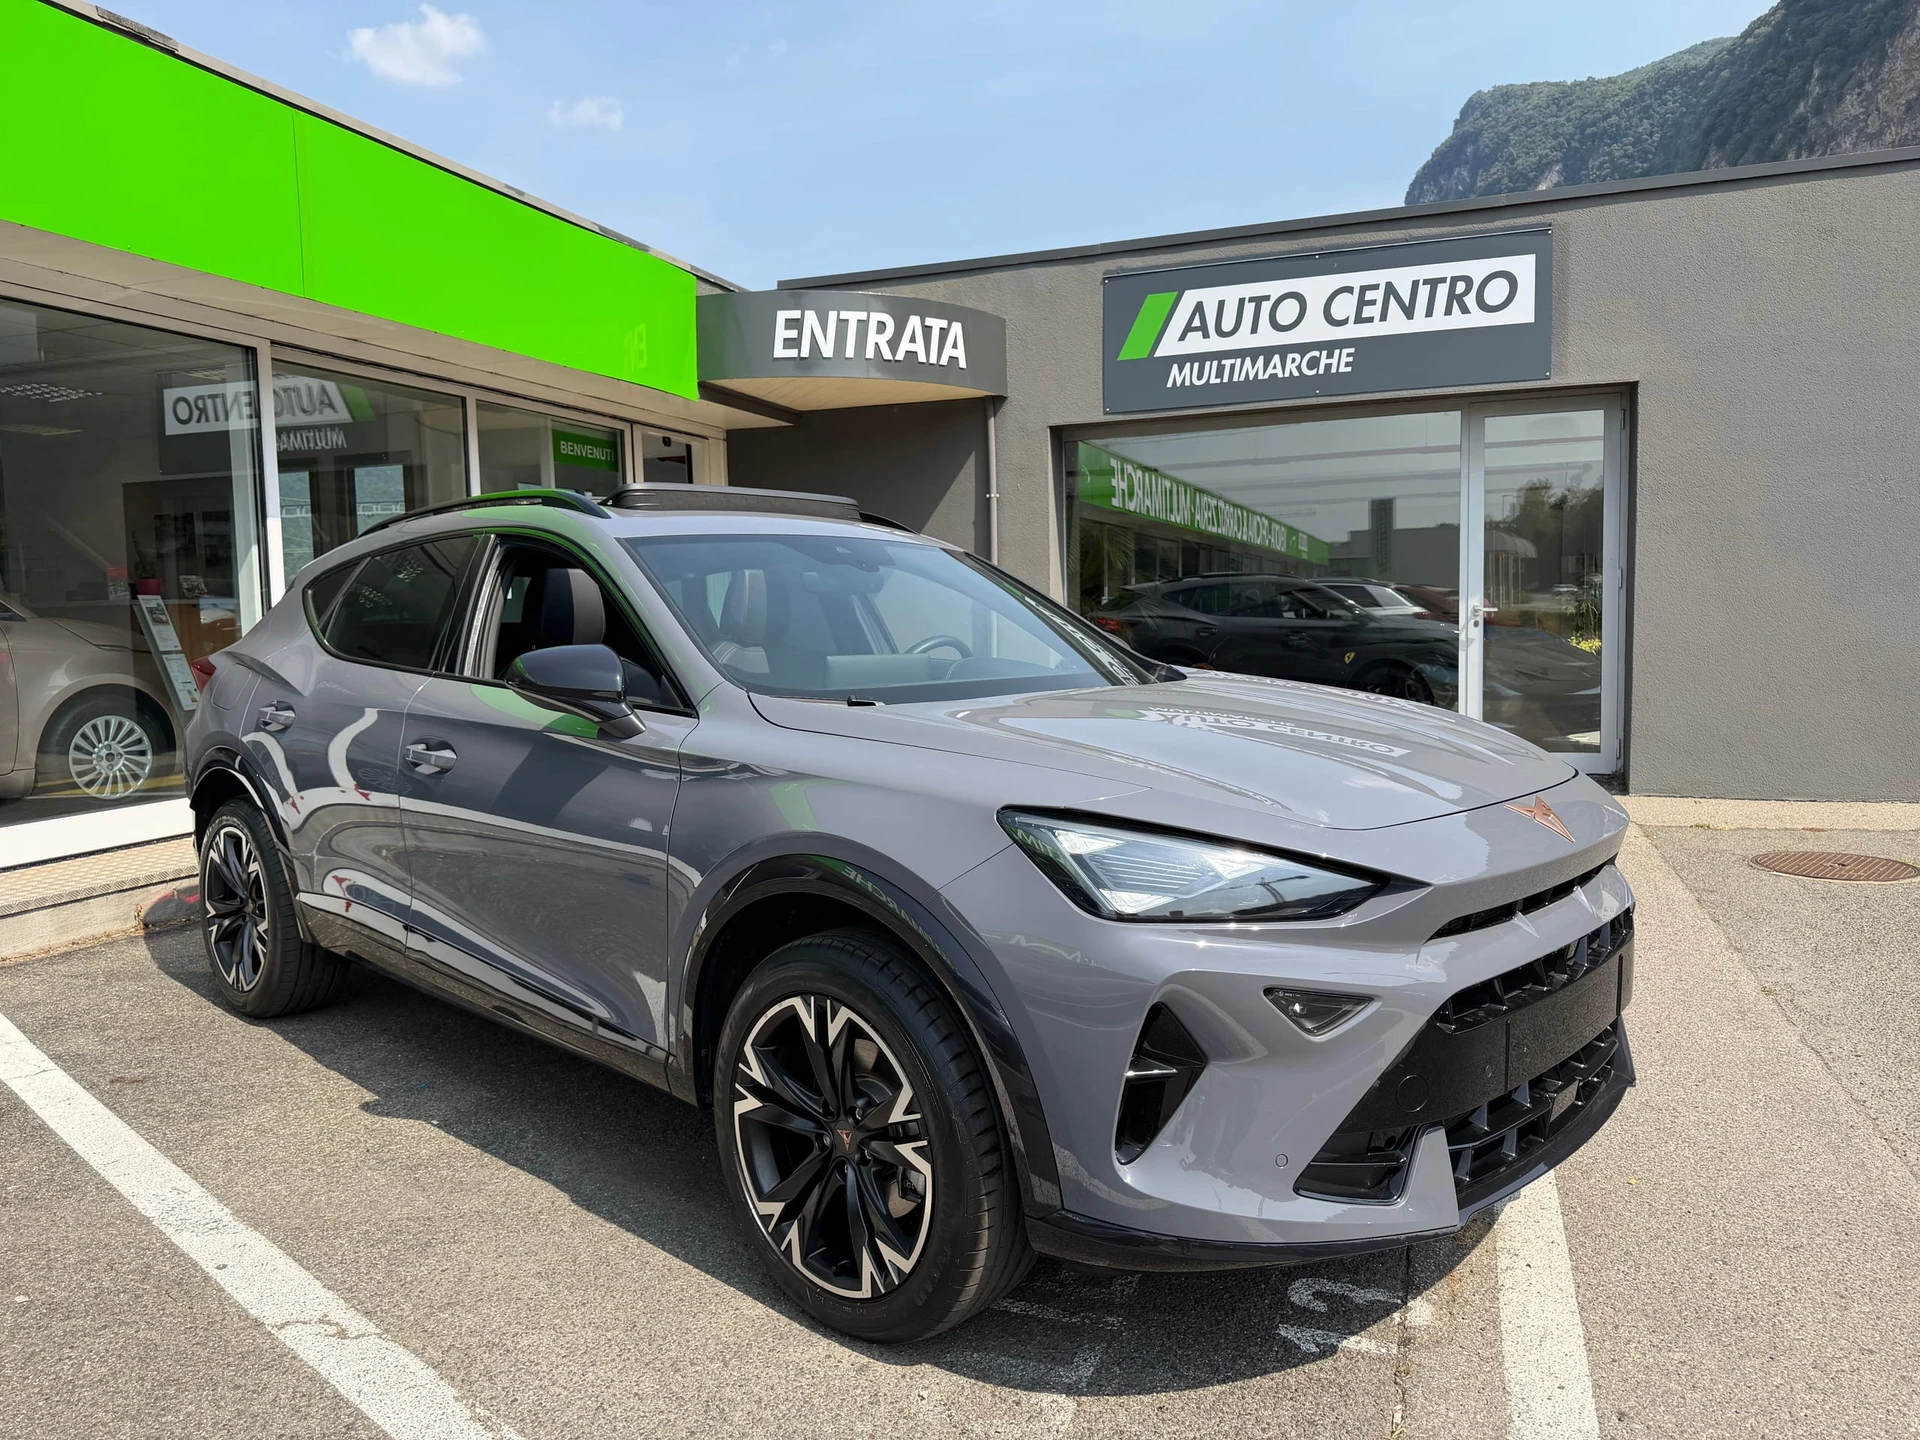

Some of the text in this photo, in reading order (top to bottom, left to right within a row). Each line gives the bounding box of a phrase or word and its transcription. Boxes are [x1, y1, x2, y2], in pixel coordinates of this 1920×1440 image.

[1177, 269, 1519, 342] AUTO CENTRO
[773, 310, 967, 369] ENTRATA
[1166, 347, 1355, 388] MULTIMARCHE
[560, 440, 615, 462] BENVENUTI
